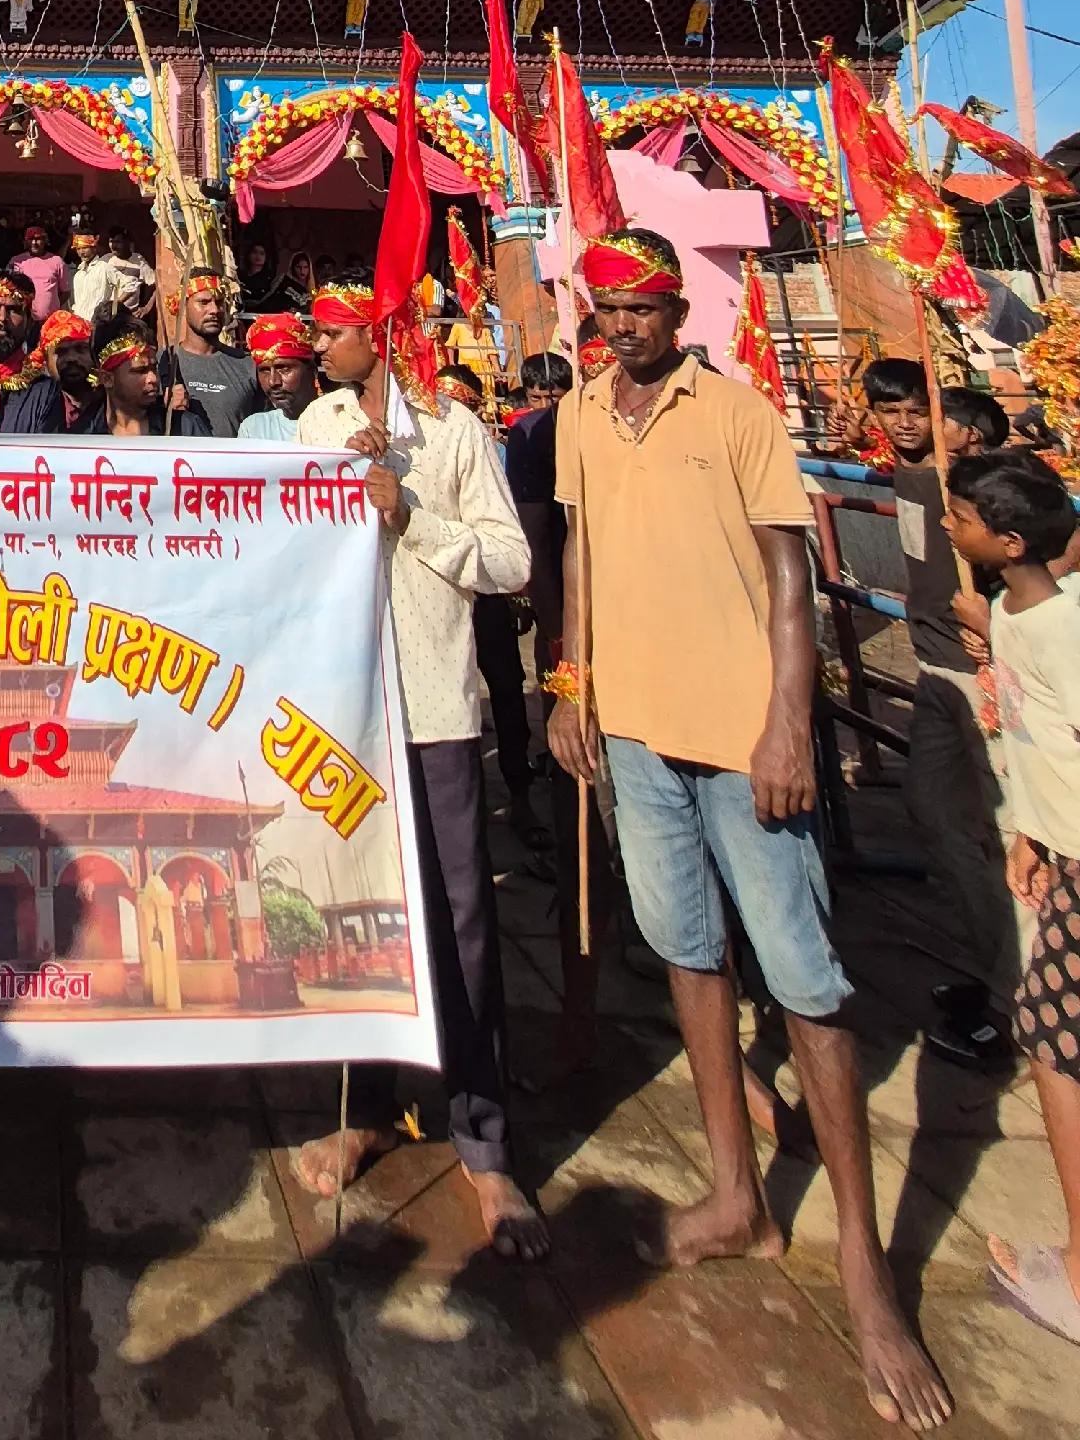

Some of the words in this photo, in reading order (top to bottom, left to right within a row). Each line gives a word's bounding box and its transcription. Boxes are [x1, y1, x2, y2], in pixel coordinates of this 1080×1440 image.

[70, 456, 158, 527] मन्दिर
[172, 458, 266, 527] विकास
[279, 460, 367, 527] समिति
[76, 533, 138, 561] भारदह
[164, 528, 223, 559] सप्तरी
[261, 696, 387, 841] यात्रा
